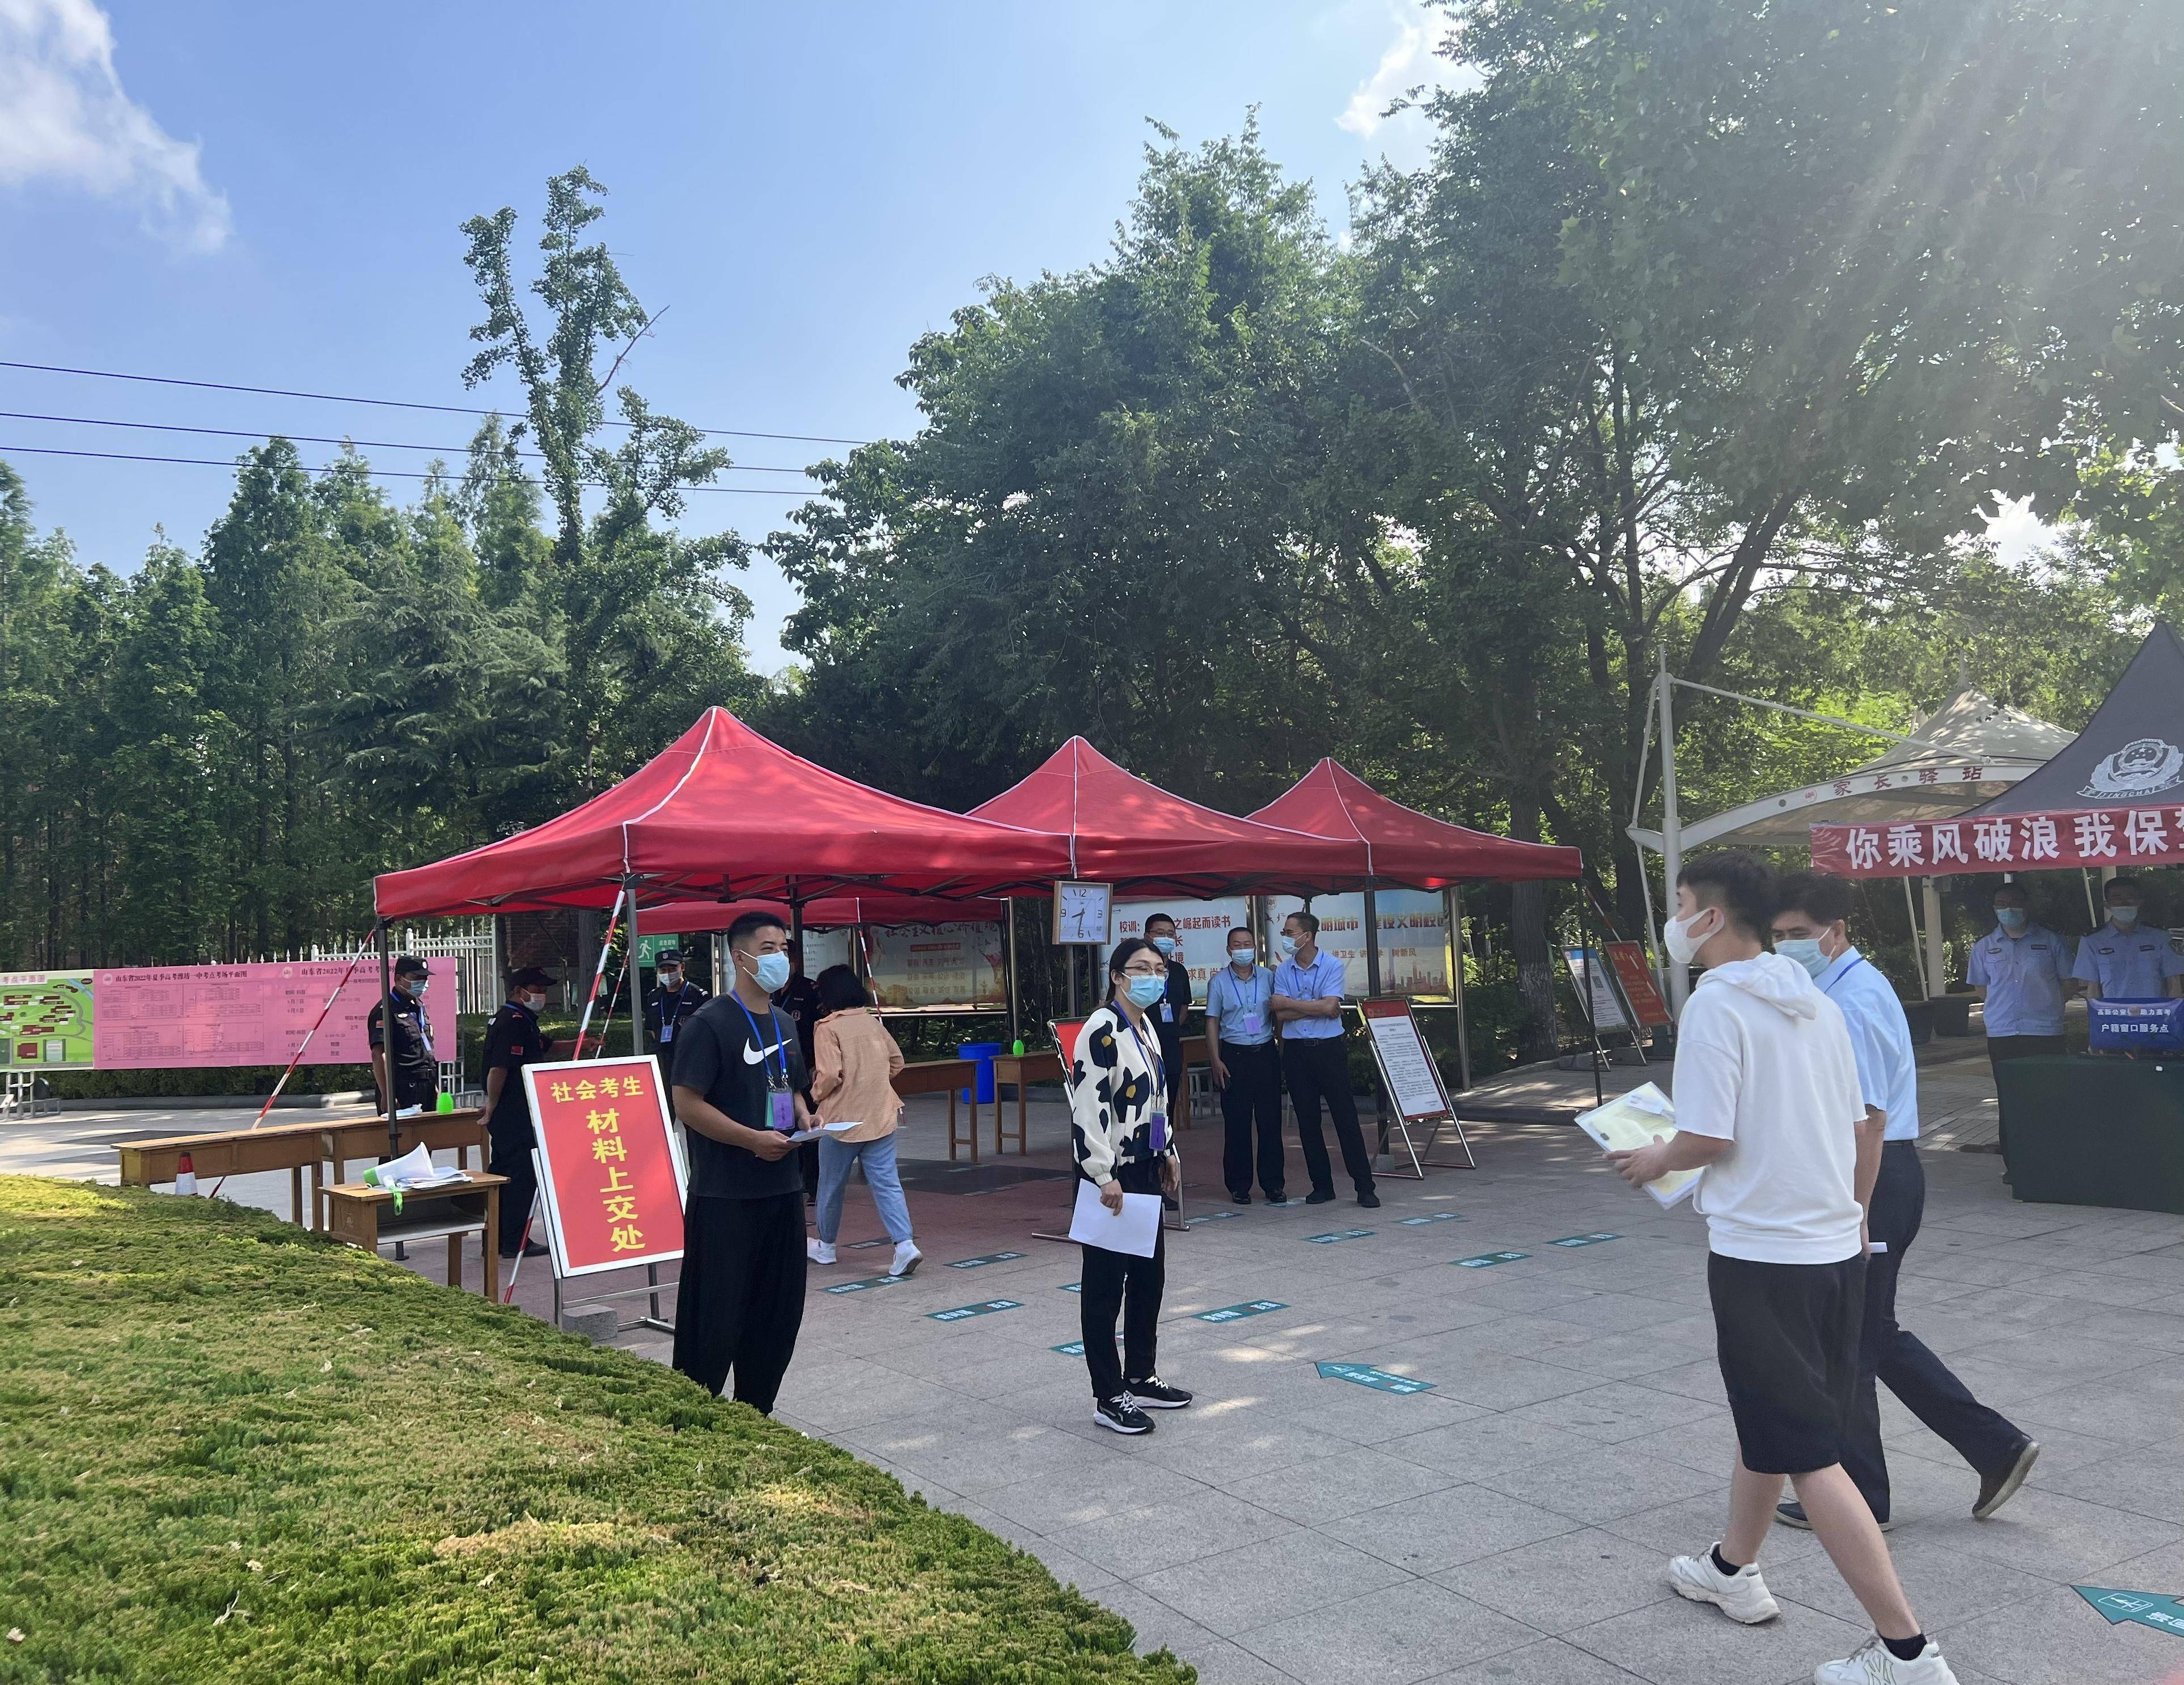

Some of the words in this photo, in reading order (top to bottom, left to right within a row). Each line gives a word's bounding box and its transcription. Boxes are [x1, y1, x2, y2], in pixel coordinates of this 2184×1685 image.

[1833, 767, 1983, 796] 家长驿站
[2099, 789, 2151, 798] JINGCHA
[1845, 816, 2060, 870] 你乘风破浪
[2073, 808, 2184, 859] 我保
[1079, 888, 1087, 897] 12
[1061, 908, 1066, 917] 9
[1097, 909, 1103, 918] 3
[1359, 949, 1383, 958] 讲学
[2101, 1023, 2169, 1033] 户籍窗口服务点
[550, 1075, 644, 1103] 社会考生
[585, 1107, 646, 1252] 材料上交处
